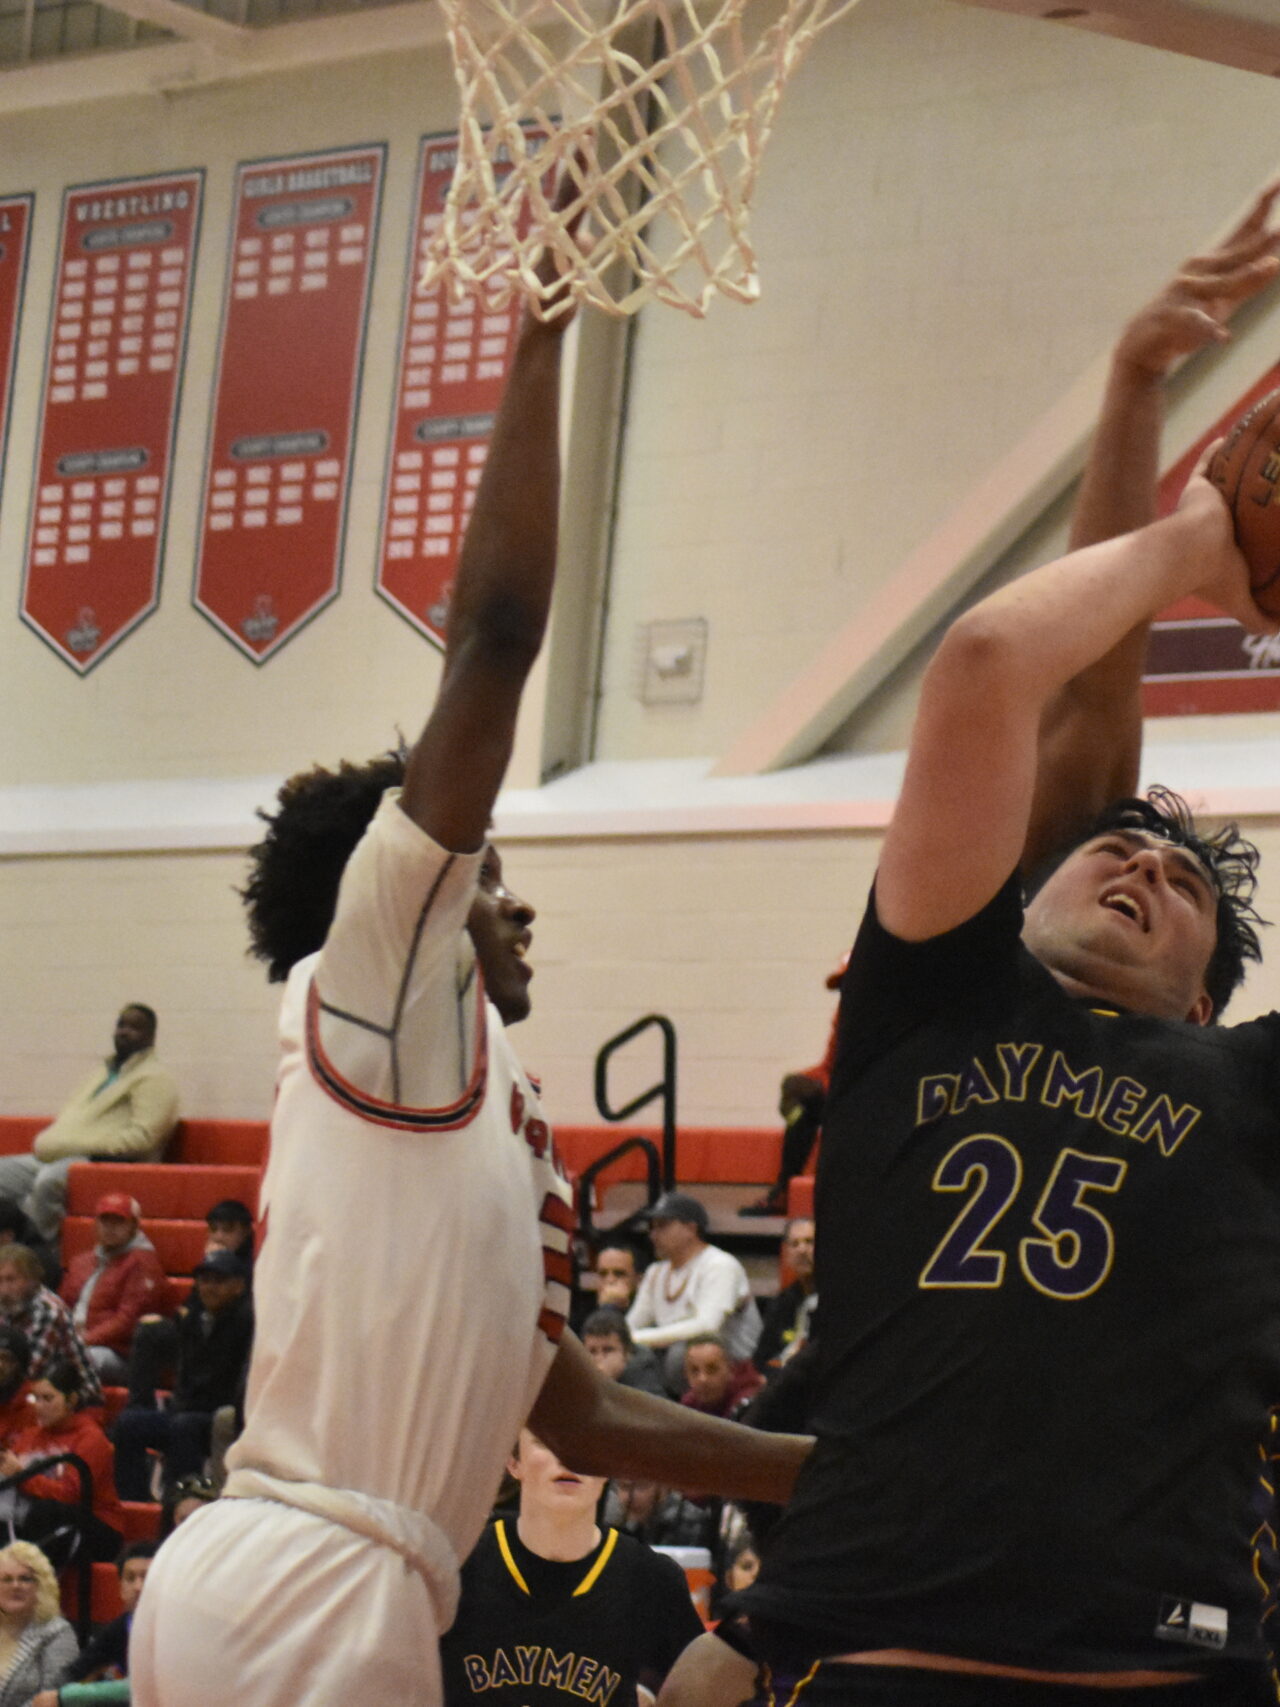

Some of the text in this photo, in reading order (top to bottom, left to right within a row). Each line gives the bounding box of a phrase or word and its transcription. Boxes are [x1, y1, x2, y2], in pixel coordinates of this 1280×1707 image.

[288, 161, 372, 192] BASKETBALL
[75, 188, 190, 222] WRESTLING
[917, 1132, 1129, 1302] 25
[463, 1645, 621, 1707] BAYMEN
